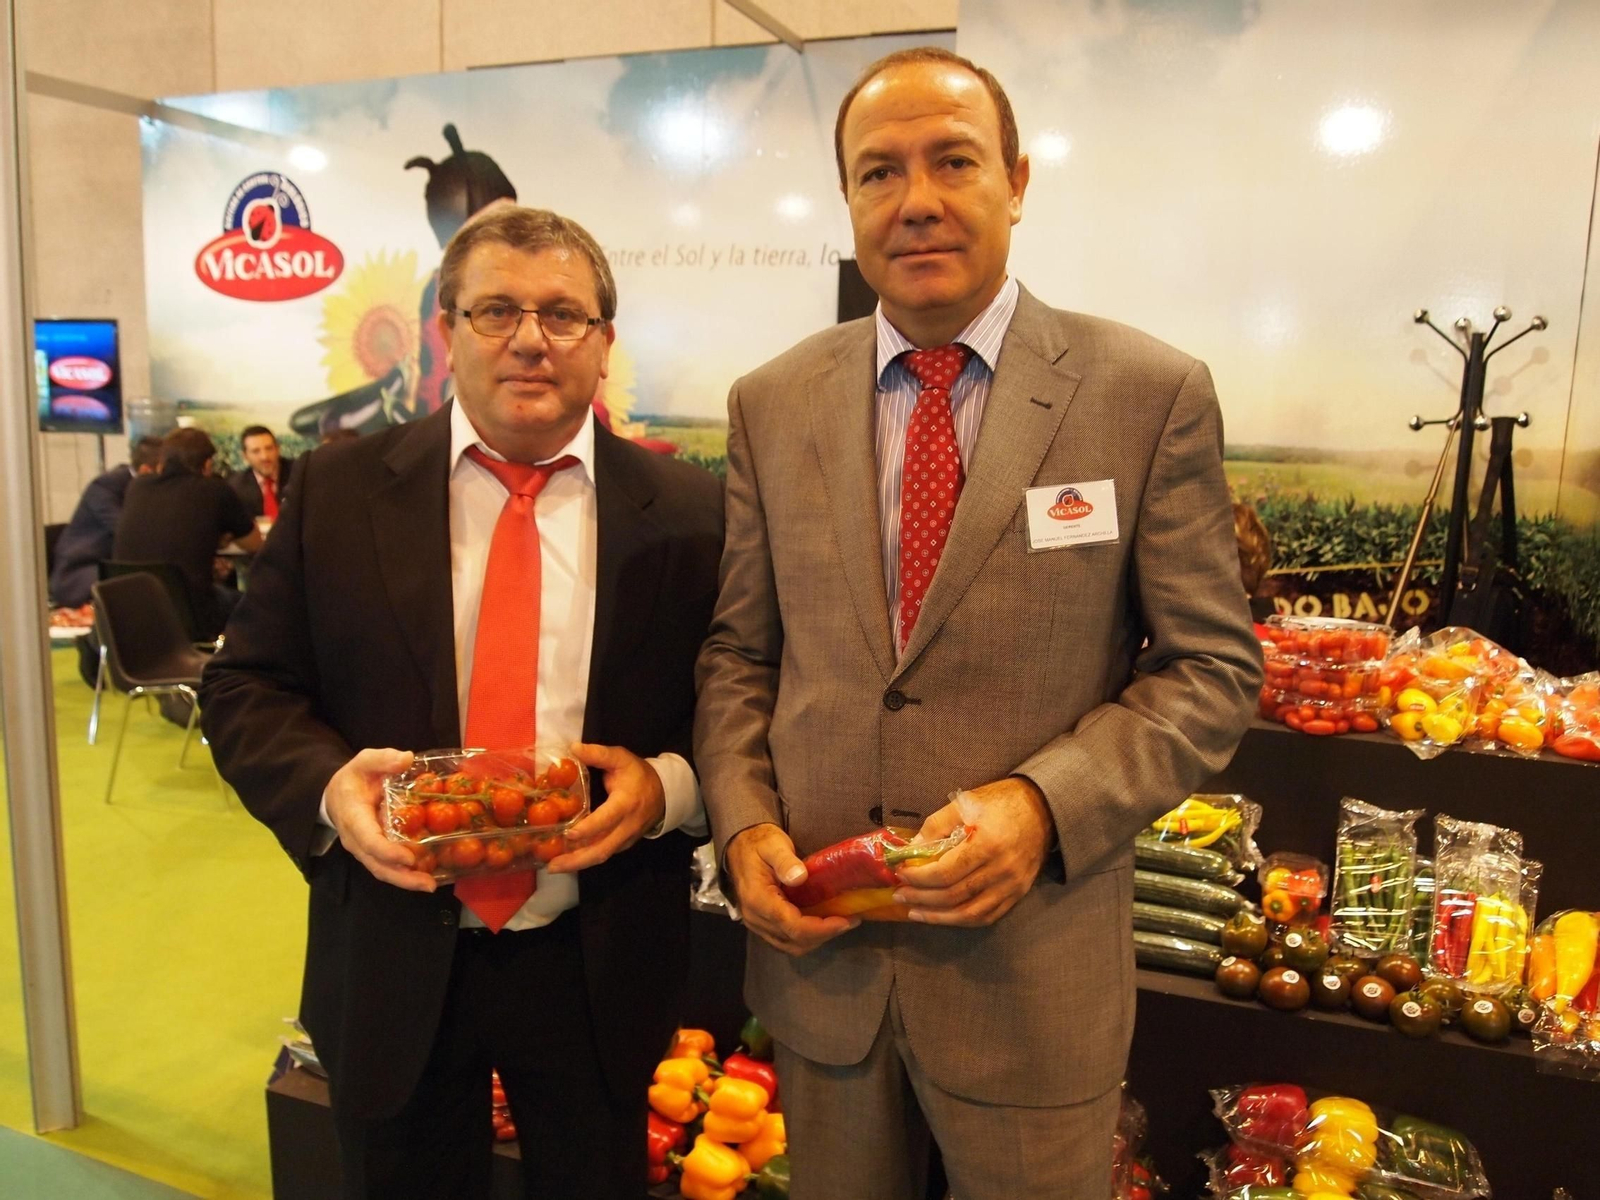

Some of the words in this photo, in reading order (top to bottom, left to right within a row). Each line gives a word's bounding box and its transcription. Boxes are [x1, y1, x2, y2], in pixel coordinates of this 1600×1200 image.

[204, 248, 335, 281] VICASOL
[603, 245, 646, 266] ntre
[651, 243, 669, 266] el
[675, 243, 706, 266] Sol
[708, 249, 722, 272] y
[728, 243, 745, 266] la
[753, 244, 811, 268] tierra,
[820, 243, 841, 266] lo
[1049, 505, 1091, 517] VICASOL
[1064, 532, 1091, 540] FERNANDEZ
